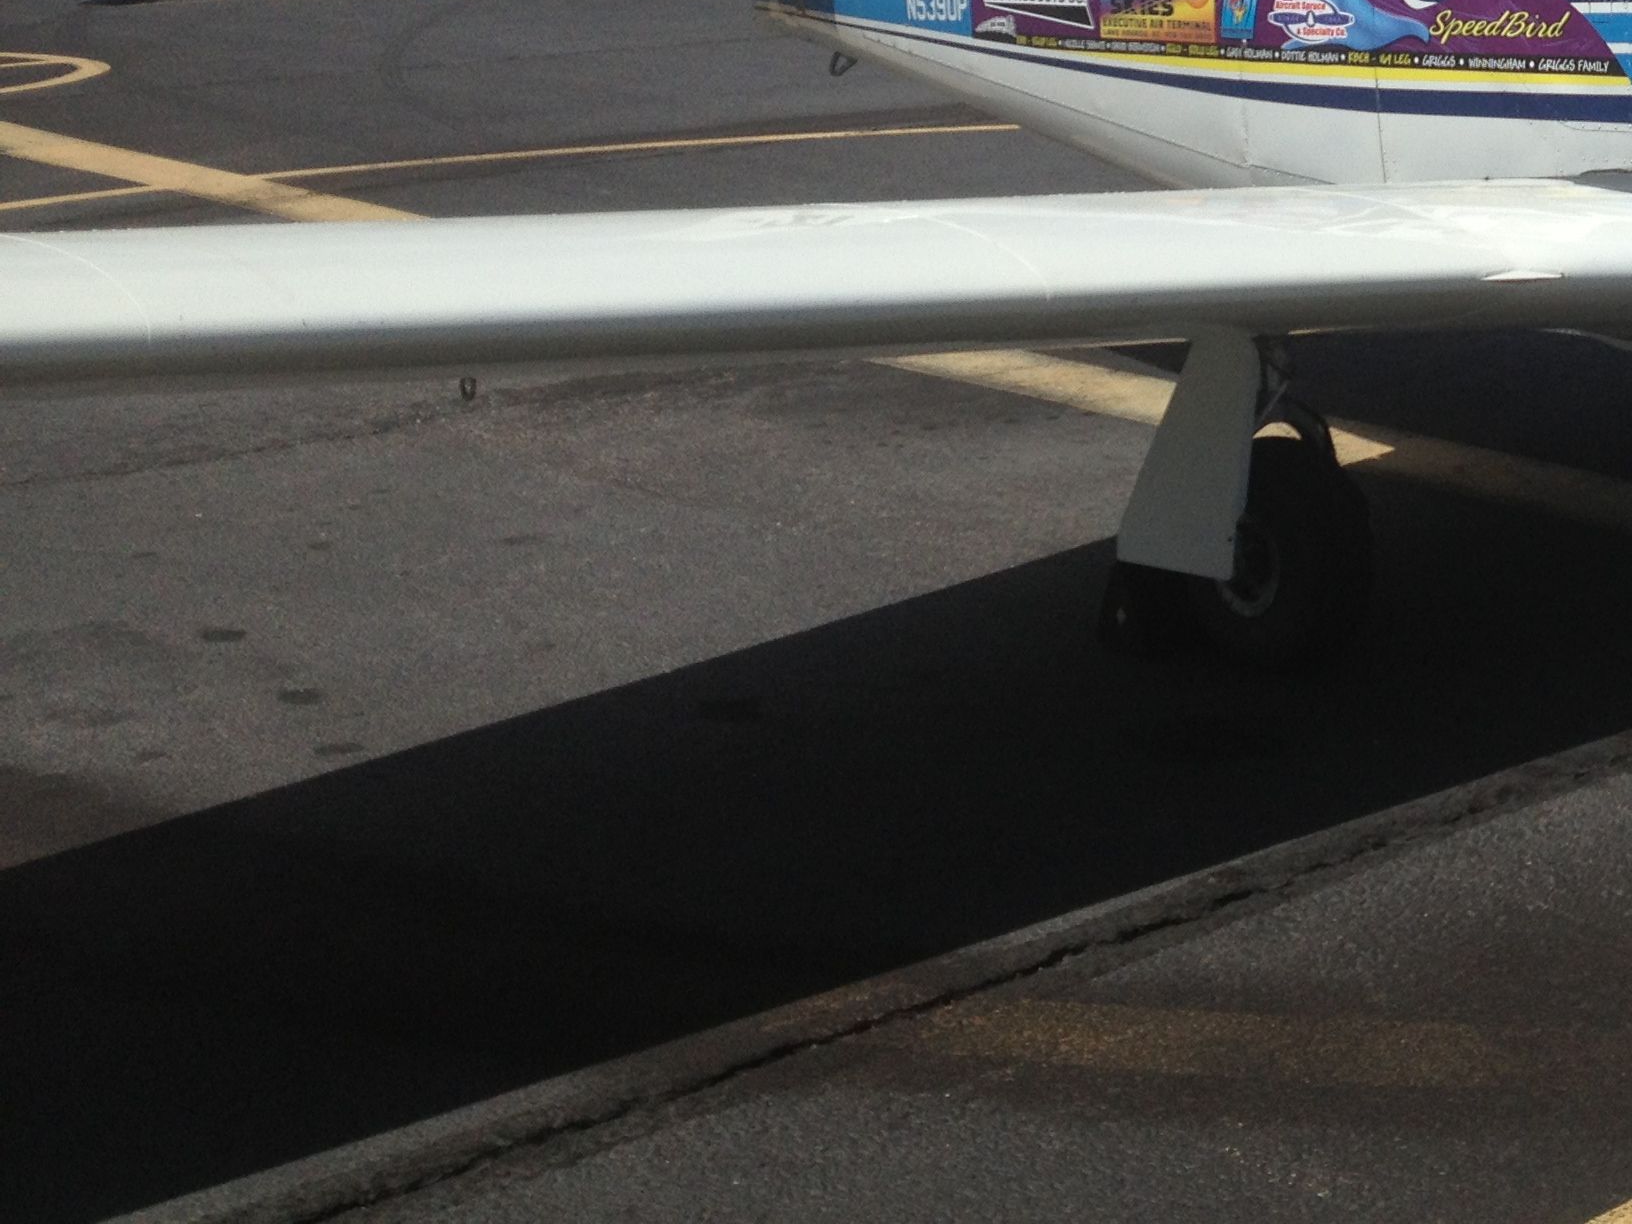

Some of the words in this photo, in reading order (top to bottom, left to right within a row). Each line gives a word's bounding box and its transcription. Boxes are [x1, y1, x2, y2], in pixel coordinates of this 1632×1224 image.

[1103, 17, 1148, 28] EXECUTIVE
[1394, 54, 1412, 65] LEG
[1422, 54, 1456, 67] GRIGGS
[1468, 57, 1526, 69] WINNINGHAM
[1538, 56, 1576, 72] GRIGGS
[1577, 60, 1610, 73] FAMILY
